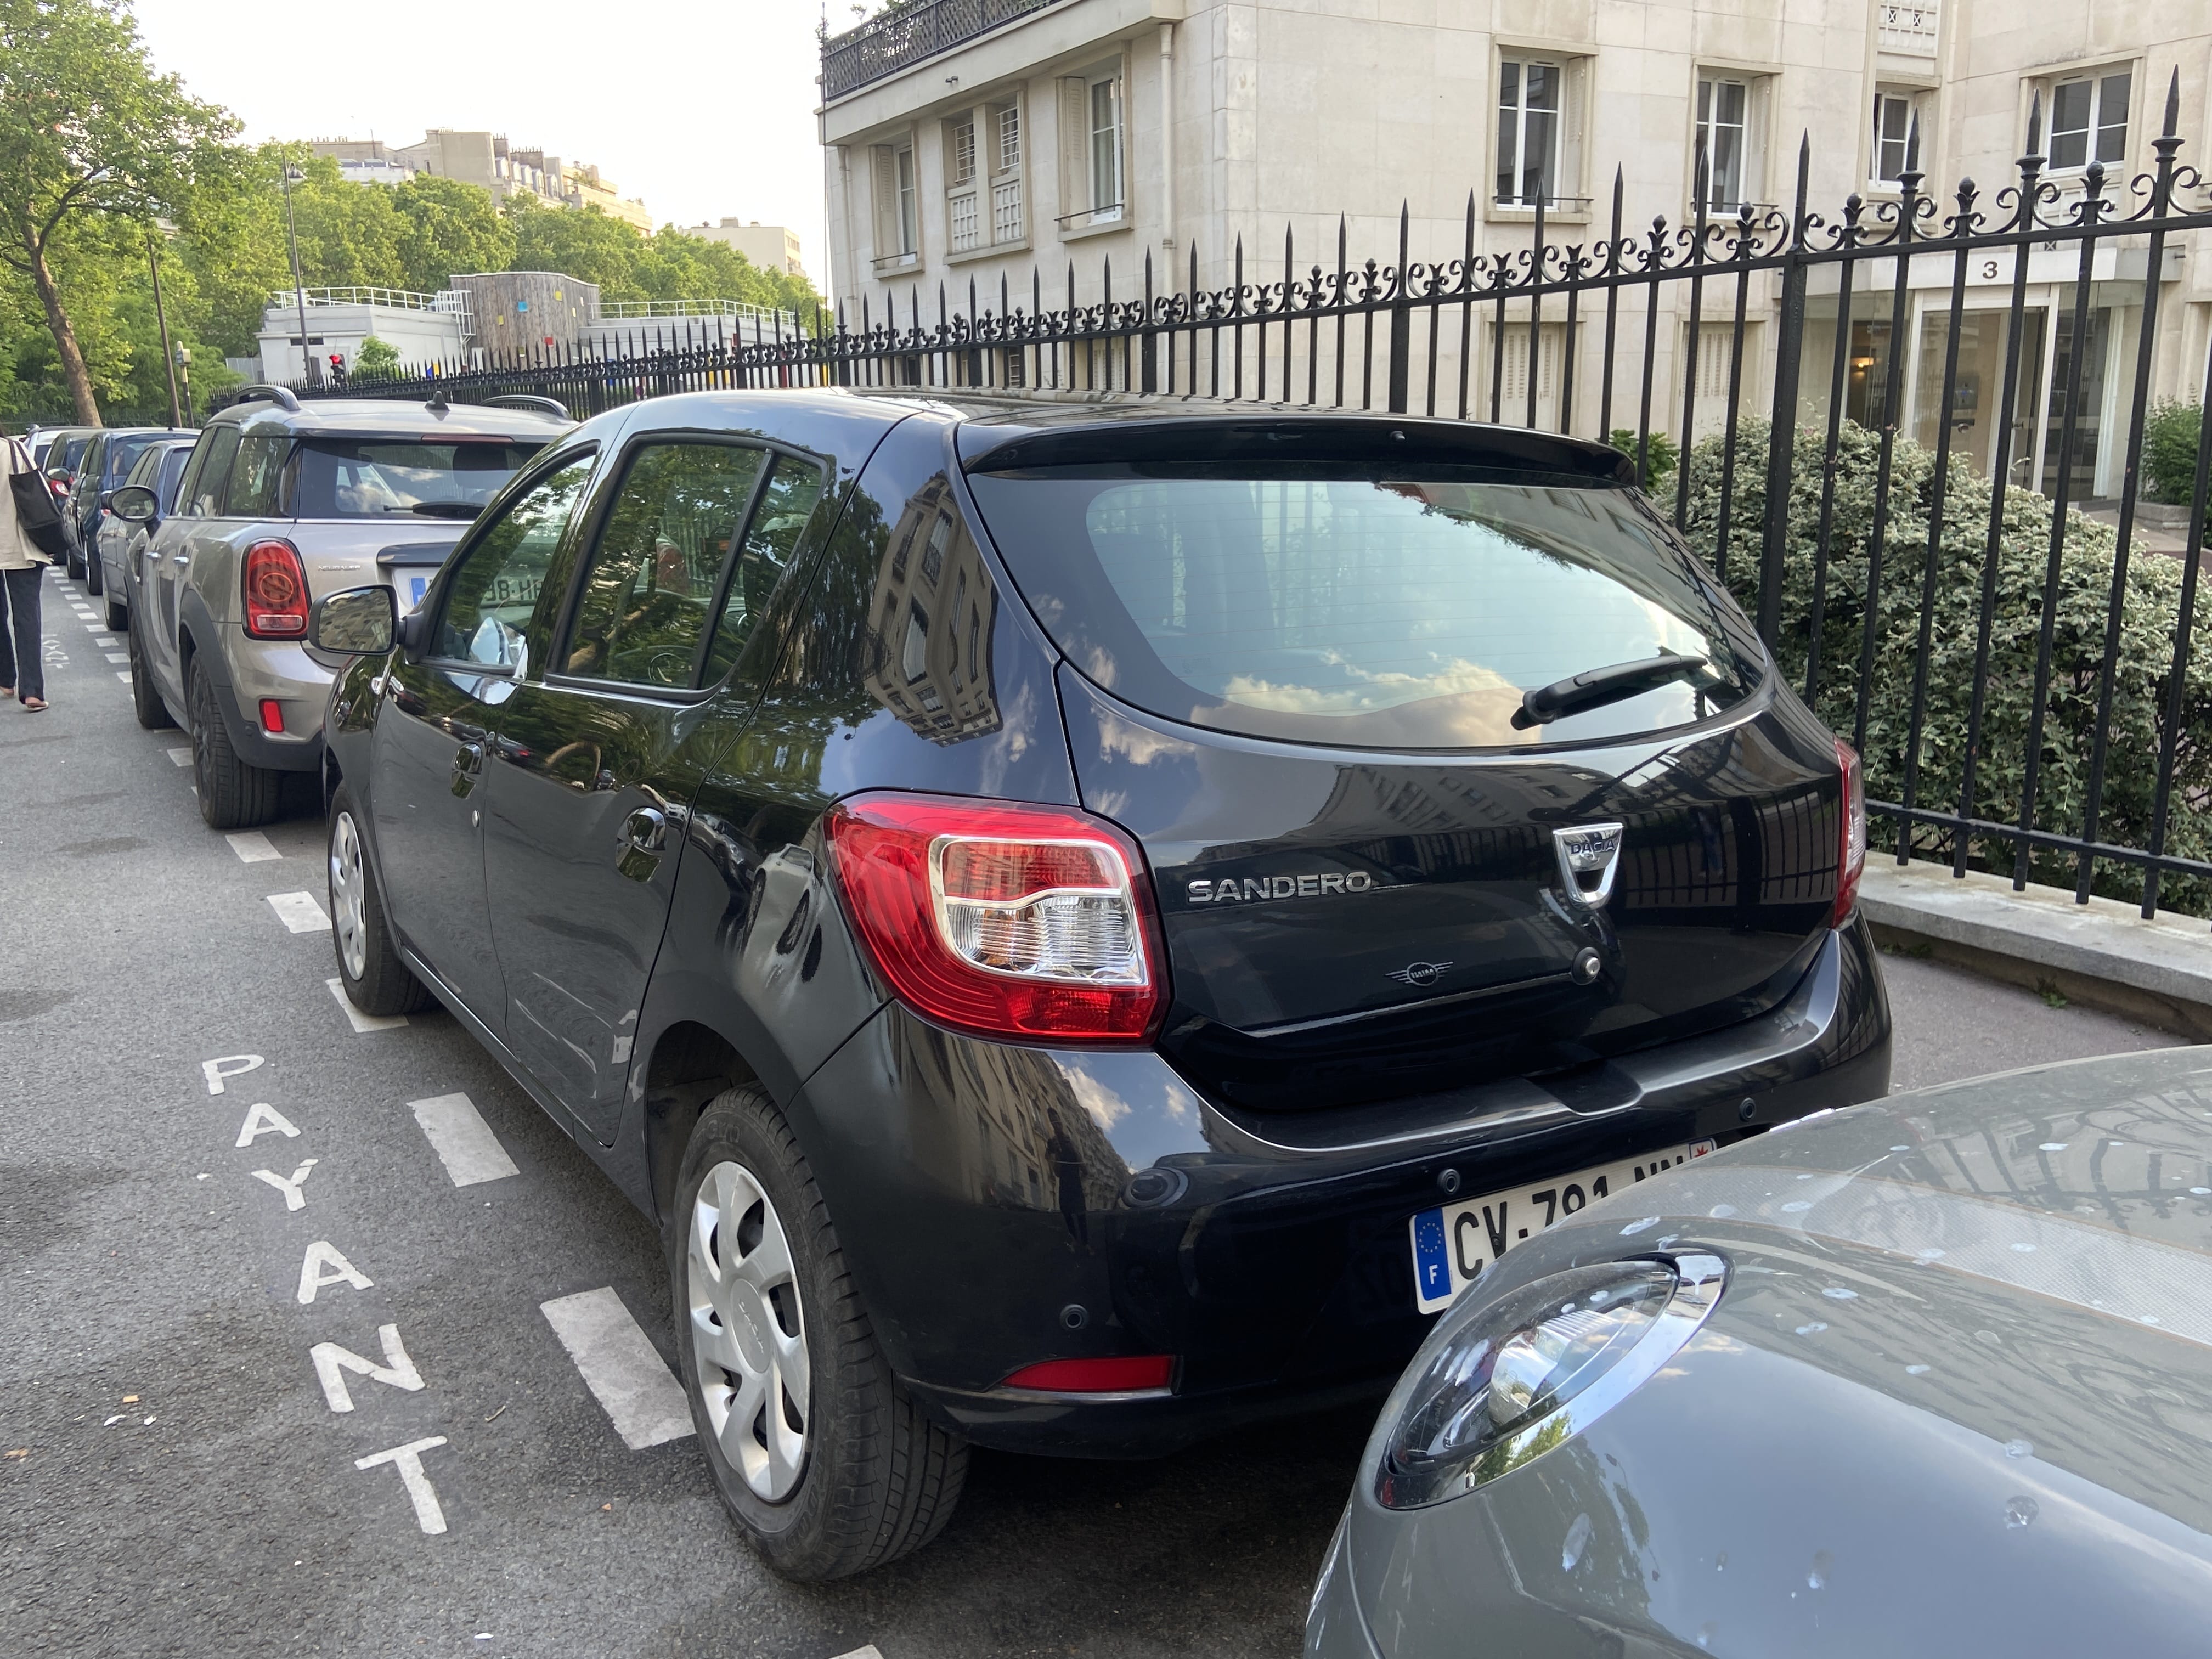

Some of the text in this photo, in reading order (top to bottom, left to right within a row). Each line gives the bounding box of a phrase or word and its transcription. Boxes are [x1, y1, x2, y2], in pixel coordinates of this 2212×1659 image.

[1982, 261, 1998, 279] 3
[1571, 839, 1616, 854] DACIA
[1188, 871, 1372, 902] SANDERO
[1429, 1265, 1438, 1284] F
[202, 1054, 448, 1535] PAYANT
